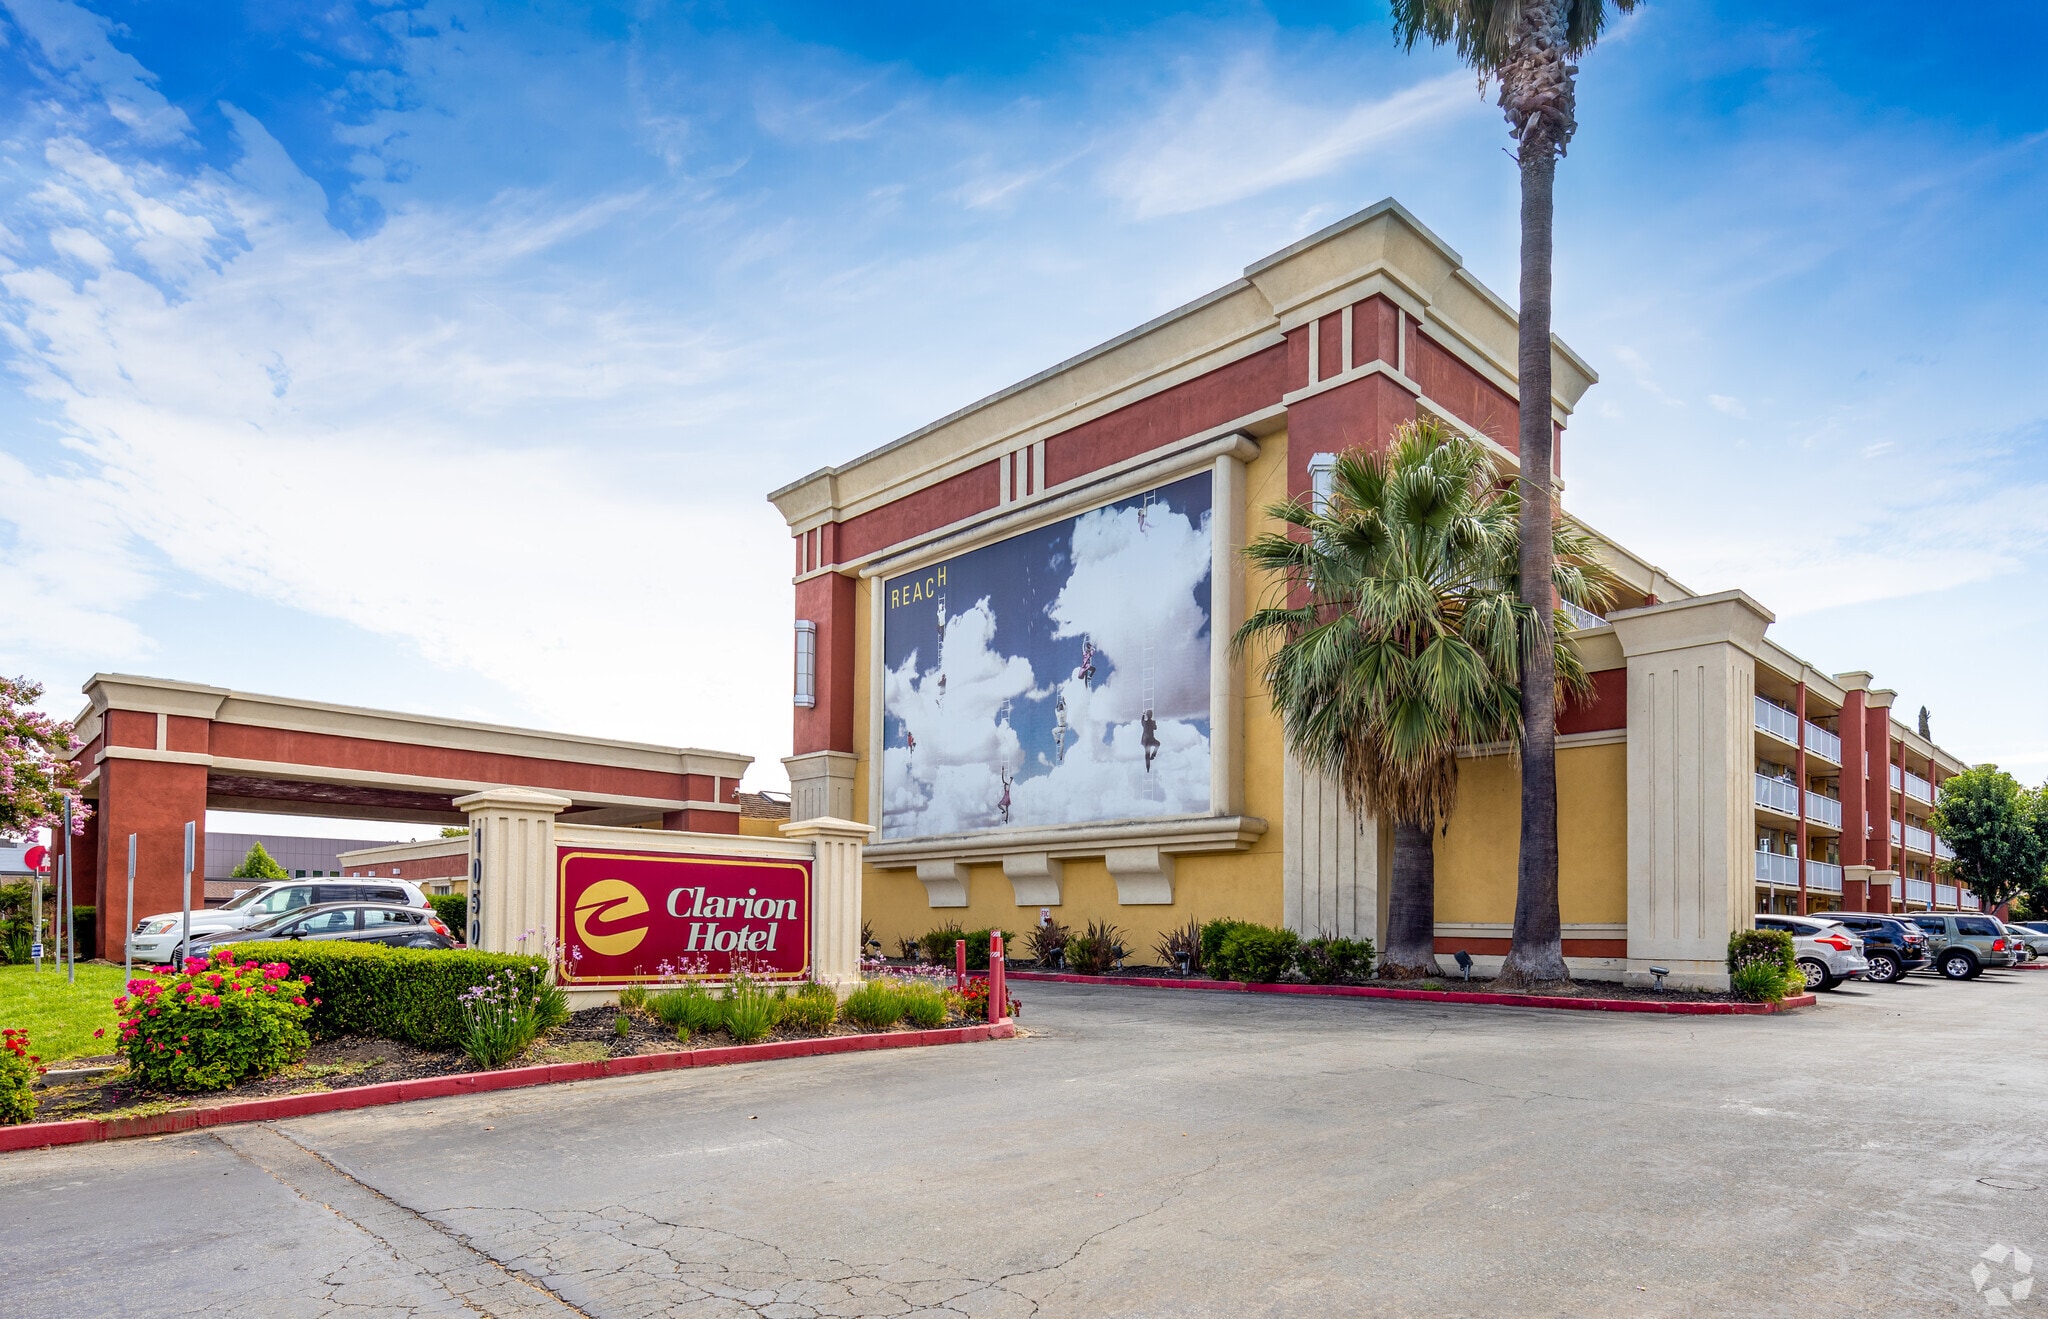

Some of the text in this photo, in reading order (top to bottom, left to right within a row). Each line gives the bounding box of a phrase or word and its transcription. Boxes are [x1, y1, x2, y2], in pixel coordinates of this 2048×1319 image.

[891, 565, 947, 609] REACH
[470, 827, 482, 946] 1050
[666, 886, 798, 920] Clarion
[683, 922, 779, 952] Hotel
